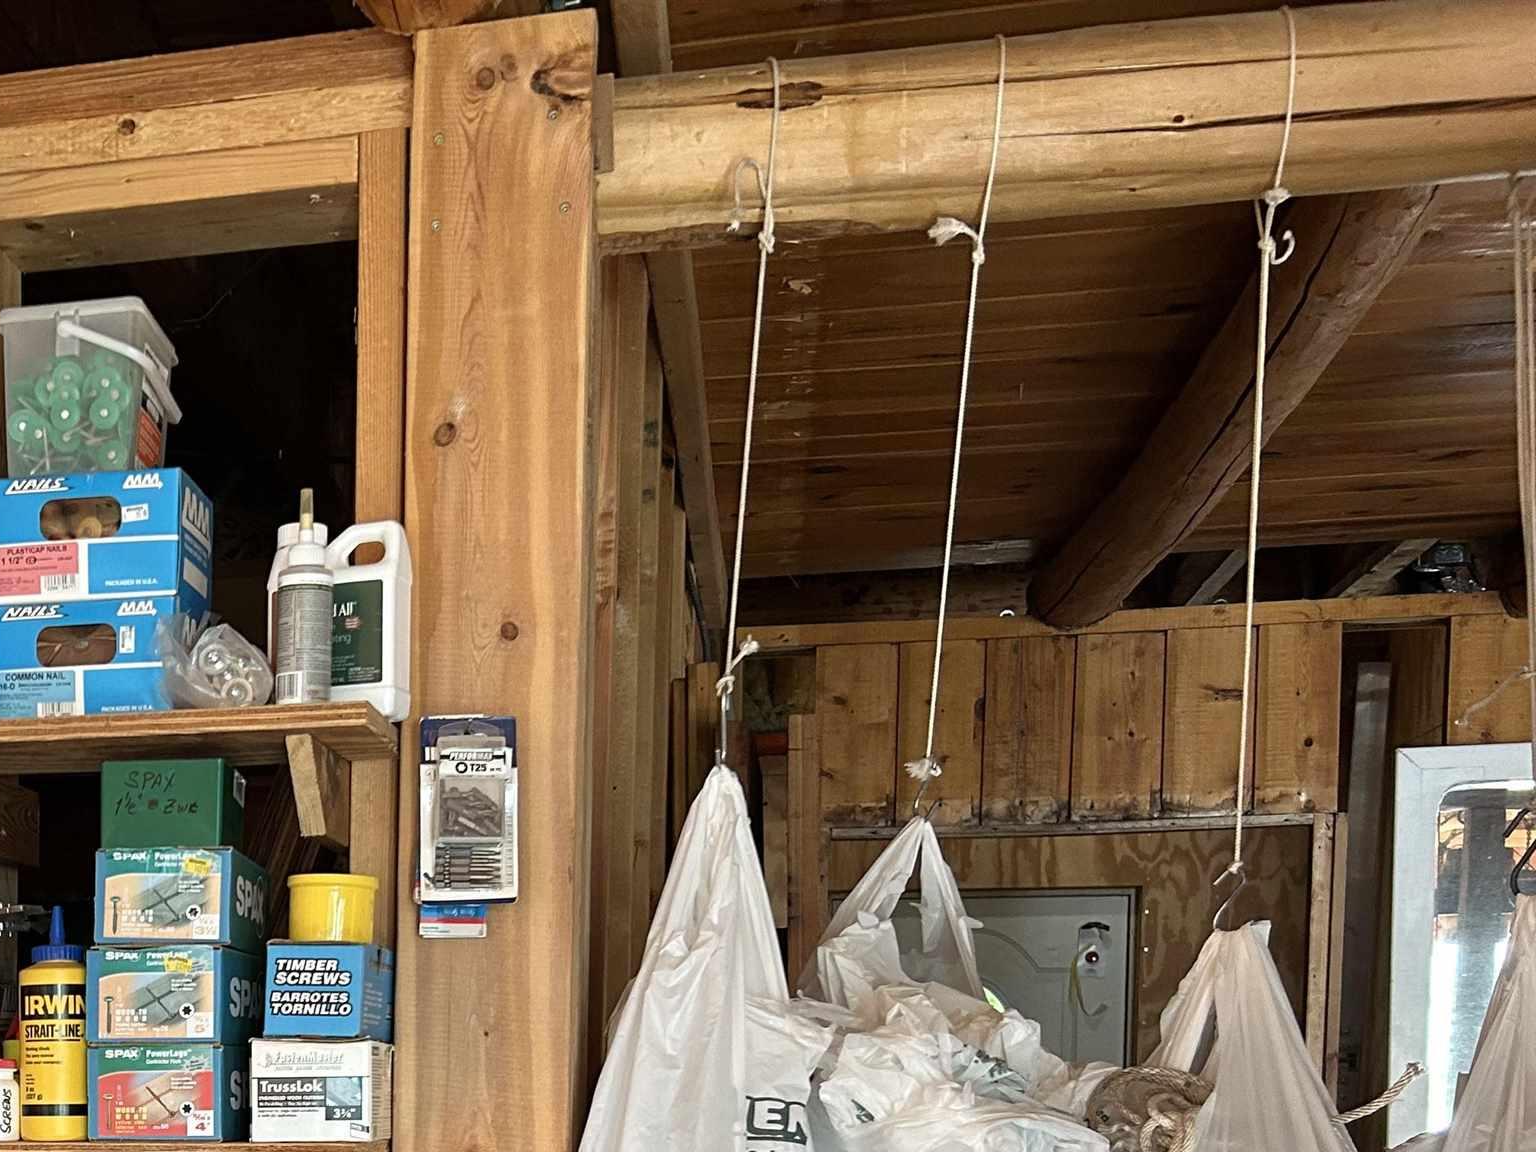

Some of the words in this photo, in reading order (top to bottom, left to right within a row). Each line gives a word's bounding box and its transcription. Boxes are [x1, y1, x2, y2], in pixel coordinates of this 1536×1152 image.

[4, 477, 69, 495] NAILS
[0, 604, 63, 622] NAILS
[4, 672, 44, 682] COMMON
[46, 671, 66, 680] NAIL
[470, 763, 488, 773] T25
[124, 771, 177, 790] SPAX
[113, 852, 147, 862] SPAX
[105, 951, 140, 961] SPAX
[275, 959, 339, 972] TIMBER
[274, 971, 352, 987] SCREWS
[271, 991, 350, 1004] BARROTES
[24, 995, 86, 1016] IRWIN
[271, 1002, 353, 1016] TORNILLO
[25, 1023, 82, 1039] STRAIT-INE
[105, 1049, 139, 1059] SPAX
[259, 1078, 323, 1093] TrussLok
